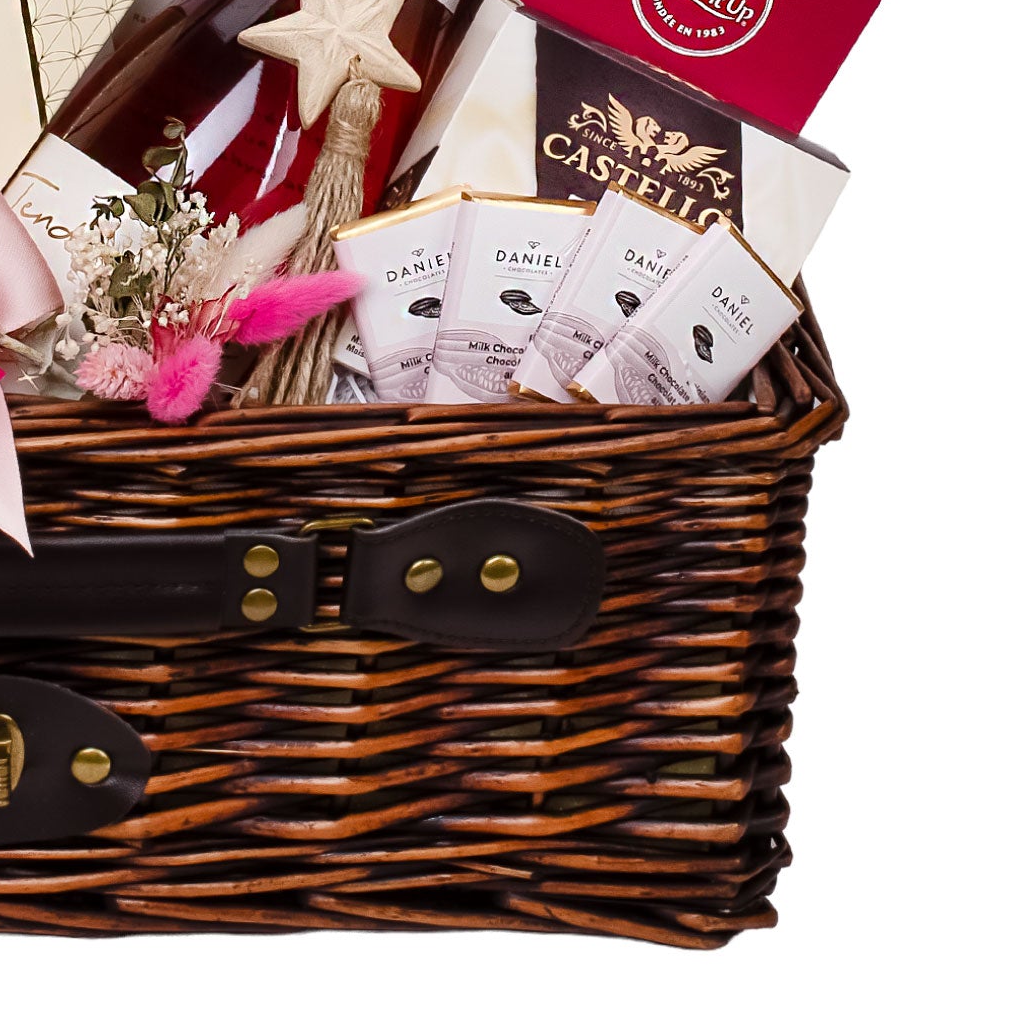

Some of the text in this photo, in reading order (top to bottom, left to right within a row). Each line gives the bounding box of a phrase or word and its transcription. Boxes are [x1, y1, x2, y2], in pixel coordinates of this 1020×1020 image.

[677, 24, 693, 37] EN
[696, 25, 725, 38] 1983
[582, 129, 618, 151] SINCE
[677, 173, 704, 193] 1893
[495, 249, 562, 268] DANIEL
[711, 286, 754, 336] DANIEL
[468, 341, 491, 352] Milk
[572, 330, 592, 346] Milk
[400, 355, 423, 370] Milk
[644, 350, 662, 370] Milk
[659, 366, 690, 402] Chocolate
